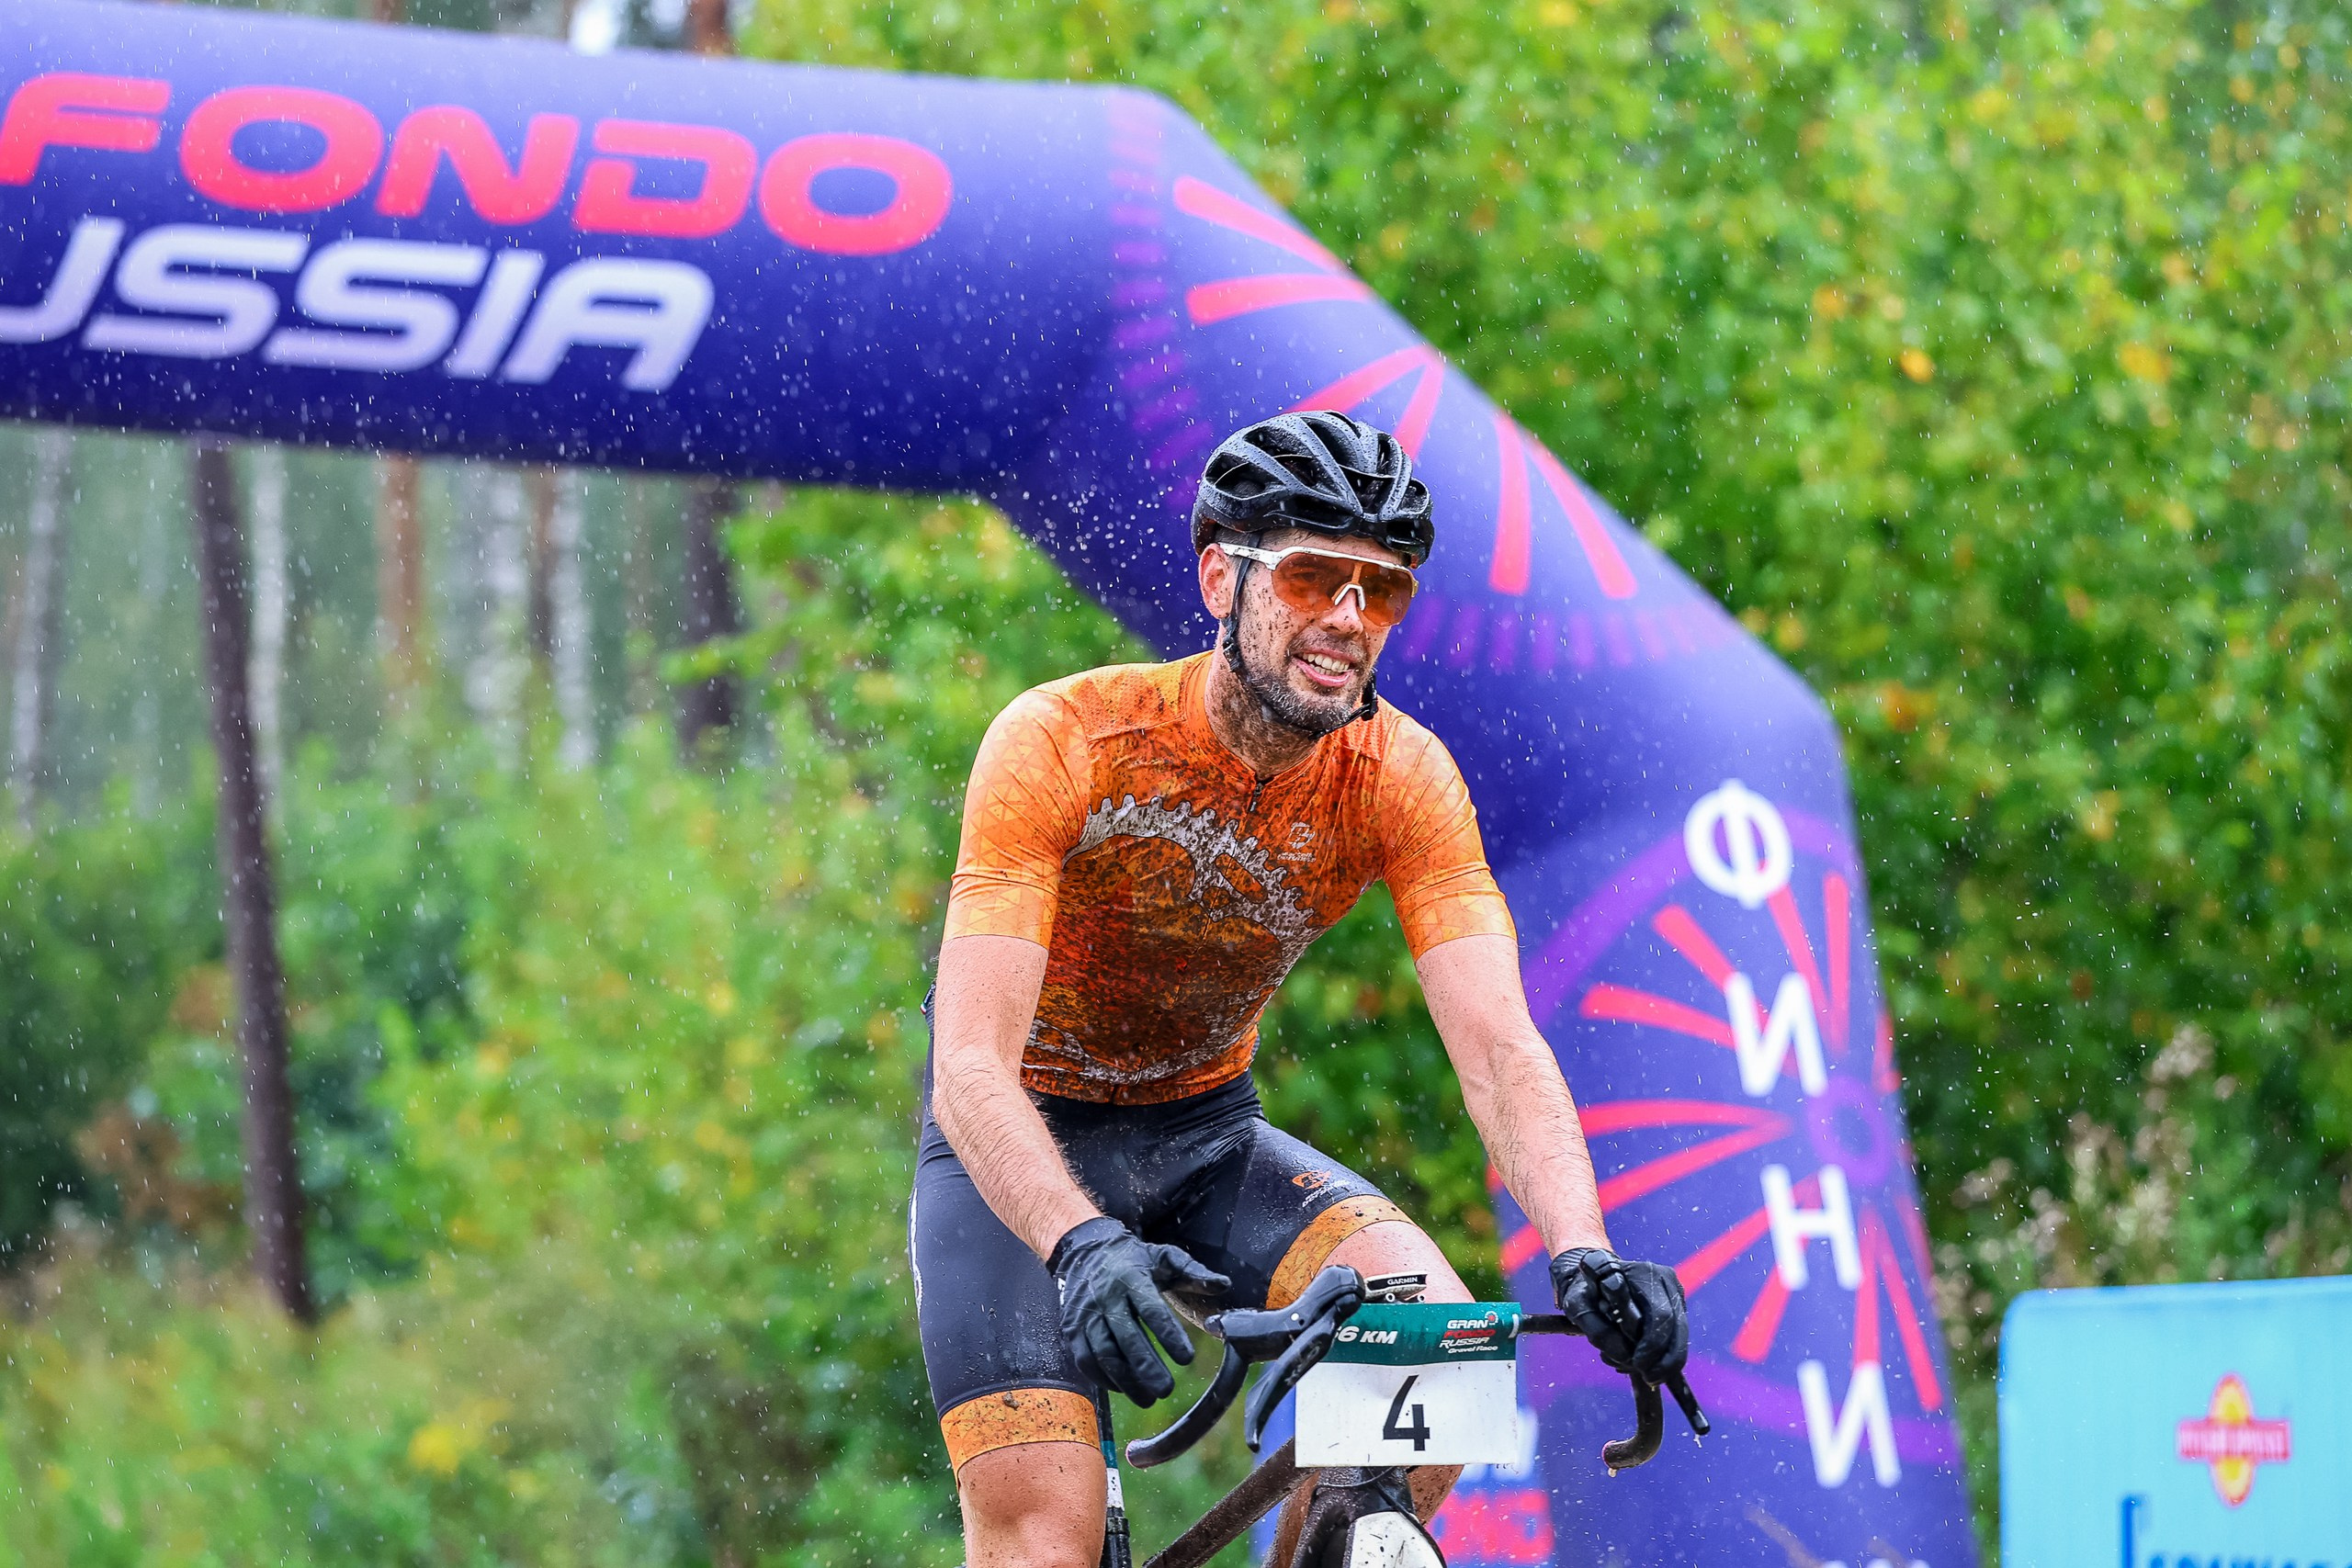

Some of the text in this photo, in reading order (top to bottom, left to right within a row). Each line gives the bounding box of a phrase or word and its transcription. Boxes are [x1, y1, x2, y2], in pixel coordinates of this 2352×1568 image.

[0, 73, 953, 255] FONDO
[1683, 779, 1931, 1568] ФИНИ
[1387, 1277, 1418, 1285] GARMIN
[1447, 1320, 1488, 1329] GRAN
[1335, 1326, 1397, 1345] 6 KM
[1443, 1329, 1496, 1338] FONDO
[1439, 1337, 1490, 1348] RUSSIA
[1383, 1375, 1430, 1451] 4
